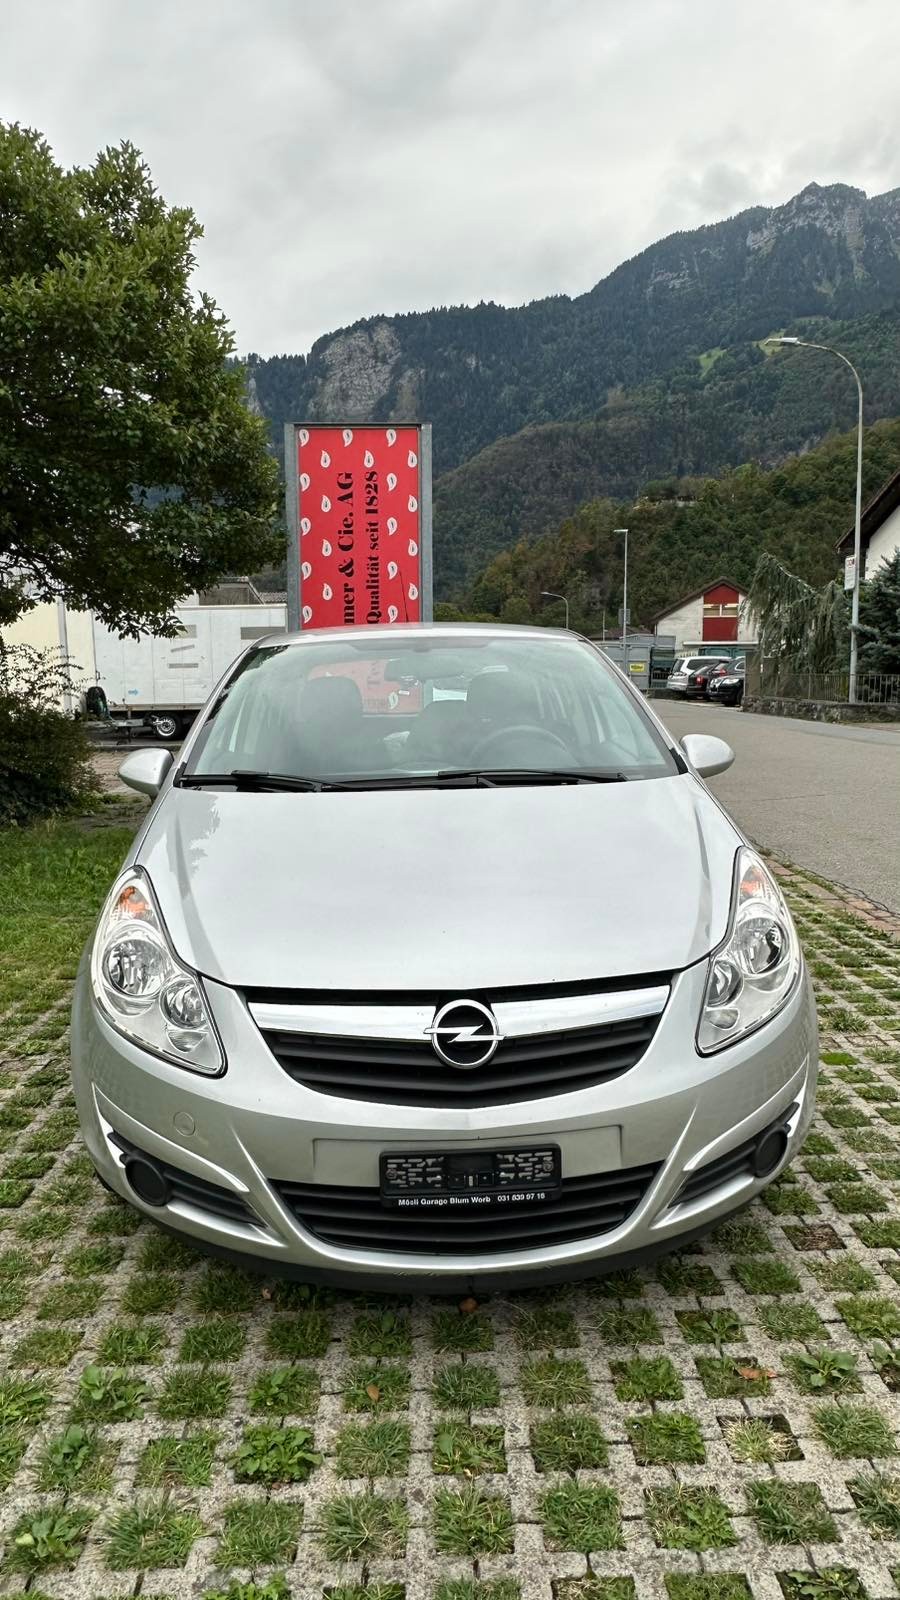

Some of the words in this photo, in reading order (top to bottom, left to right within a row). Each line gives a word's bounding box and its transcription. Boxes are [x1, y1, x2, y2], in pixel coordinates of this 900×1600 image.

[336, 471, 354, 508] AG
[364, 470, 379, 515] 1828
[337, 512, 354, 552] Cie.
[365, 521, 380, 551] seit
[338, 557, 355, 578] &
[343, 582, 355, 625] mer
[365, 556, 382, 625] Qualität
[470, 1195, 491, 1204] Worb
[497, 1194, 510, 1203] 031
